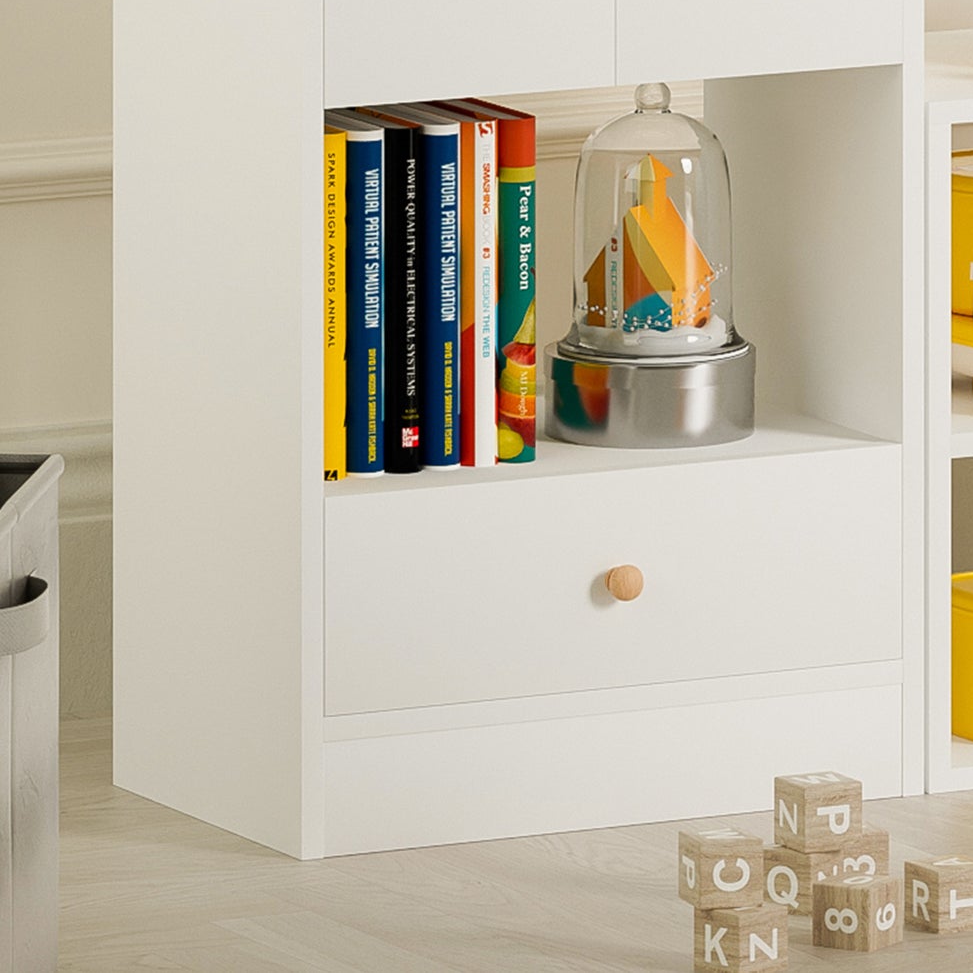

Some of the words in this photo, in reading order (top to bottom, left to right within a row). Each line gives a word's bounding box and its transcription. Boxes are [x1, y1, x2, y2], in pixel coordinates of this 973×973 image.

[365, 169, 379, 214] VIRTUAL
[406, 159, 416, 199] POWER
[441, 163, 455, 208] VIRTUAL
[482, 163, 490, 215] SMASHING
[520, 185, 532, 221] Pear
[365, 217, 379, 259] PATIENT
[405, 203, 416, 254] QUALITY
[441, 211, 455, 253] PATIENT
[520, 225, 532, 238] &
[520, 243, 532, 290] Bacon
[365, 262, 379, 328] SIMULATION
[406, 270, 416, 342] ELECTRICAL
[441, 256, 455, 321] SIMULATION
[406, 344, 416, 396] SYSTEMS
[817, 805, 850, 834] P
[682, 854, 696, 889] P
[712, 858, 750, 891] C
[767, 865, 799, 908] Q
[824, 907, 858, 934] 8
[912, 879, 931, 922] R
[704, 924, 728, 967] K
